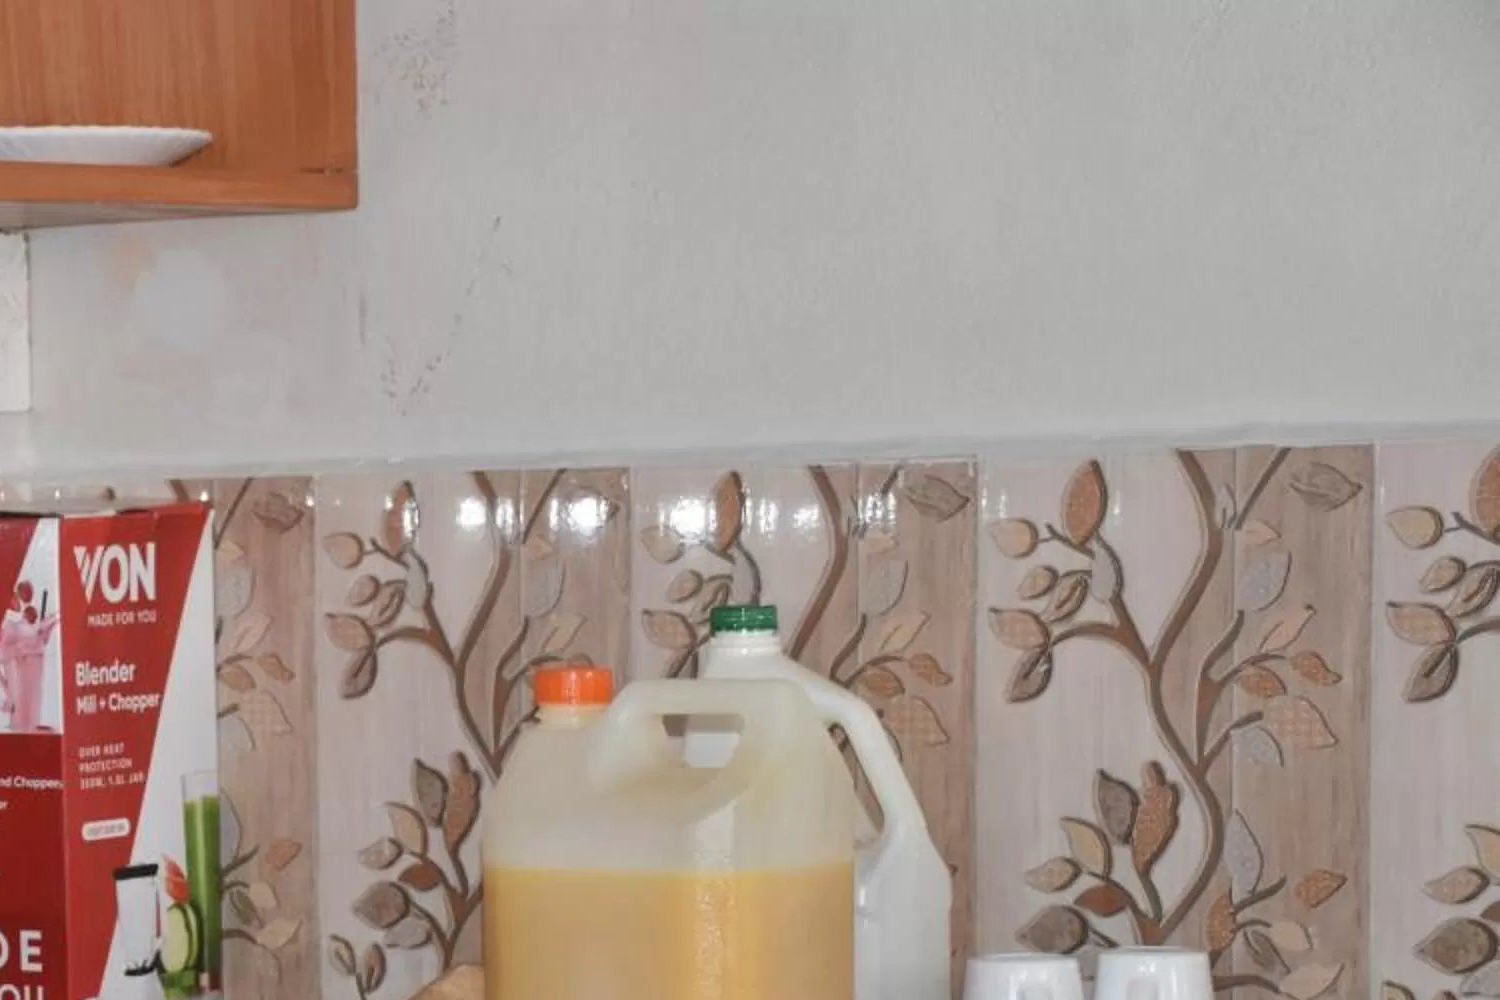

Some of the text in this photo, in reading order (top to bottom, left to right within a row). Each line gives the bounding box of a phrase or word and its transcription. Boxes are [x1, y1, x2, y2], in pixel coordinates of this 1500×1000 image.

[73, 541, 156, 605] VON
[87, 609, 157, 627] MADE FOR YOU
[75, 658, 136, 687] Blender
[76, 693, 97, 715] Mill
[107, 692, 161, 713] Chopper
[79, 758, 133, 773] PROTECTION
